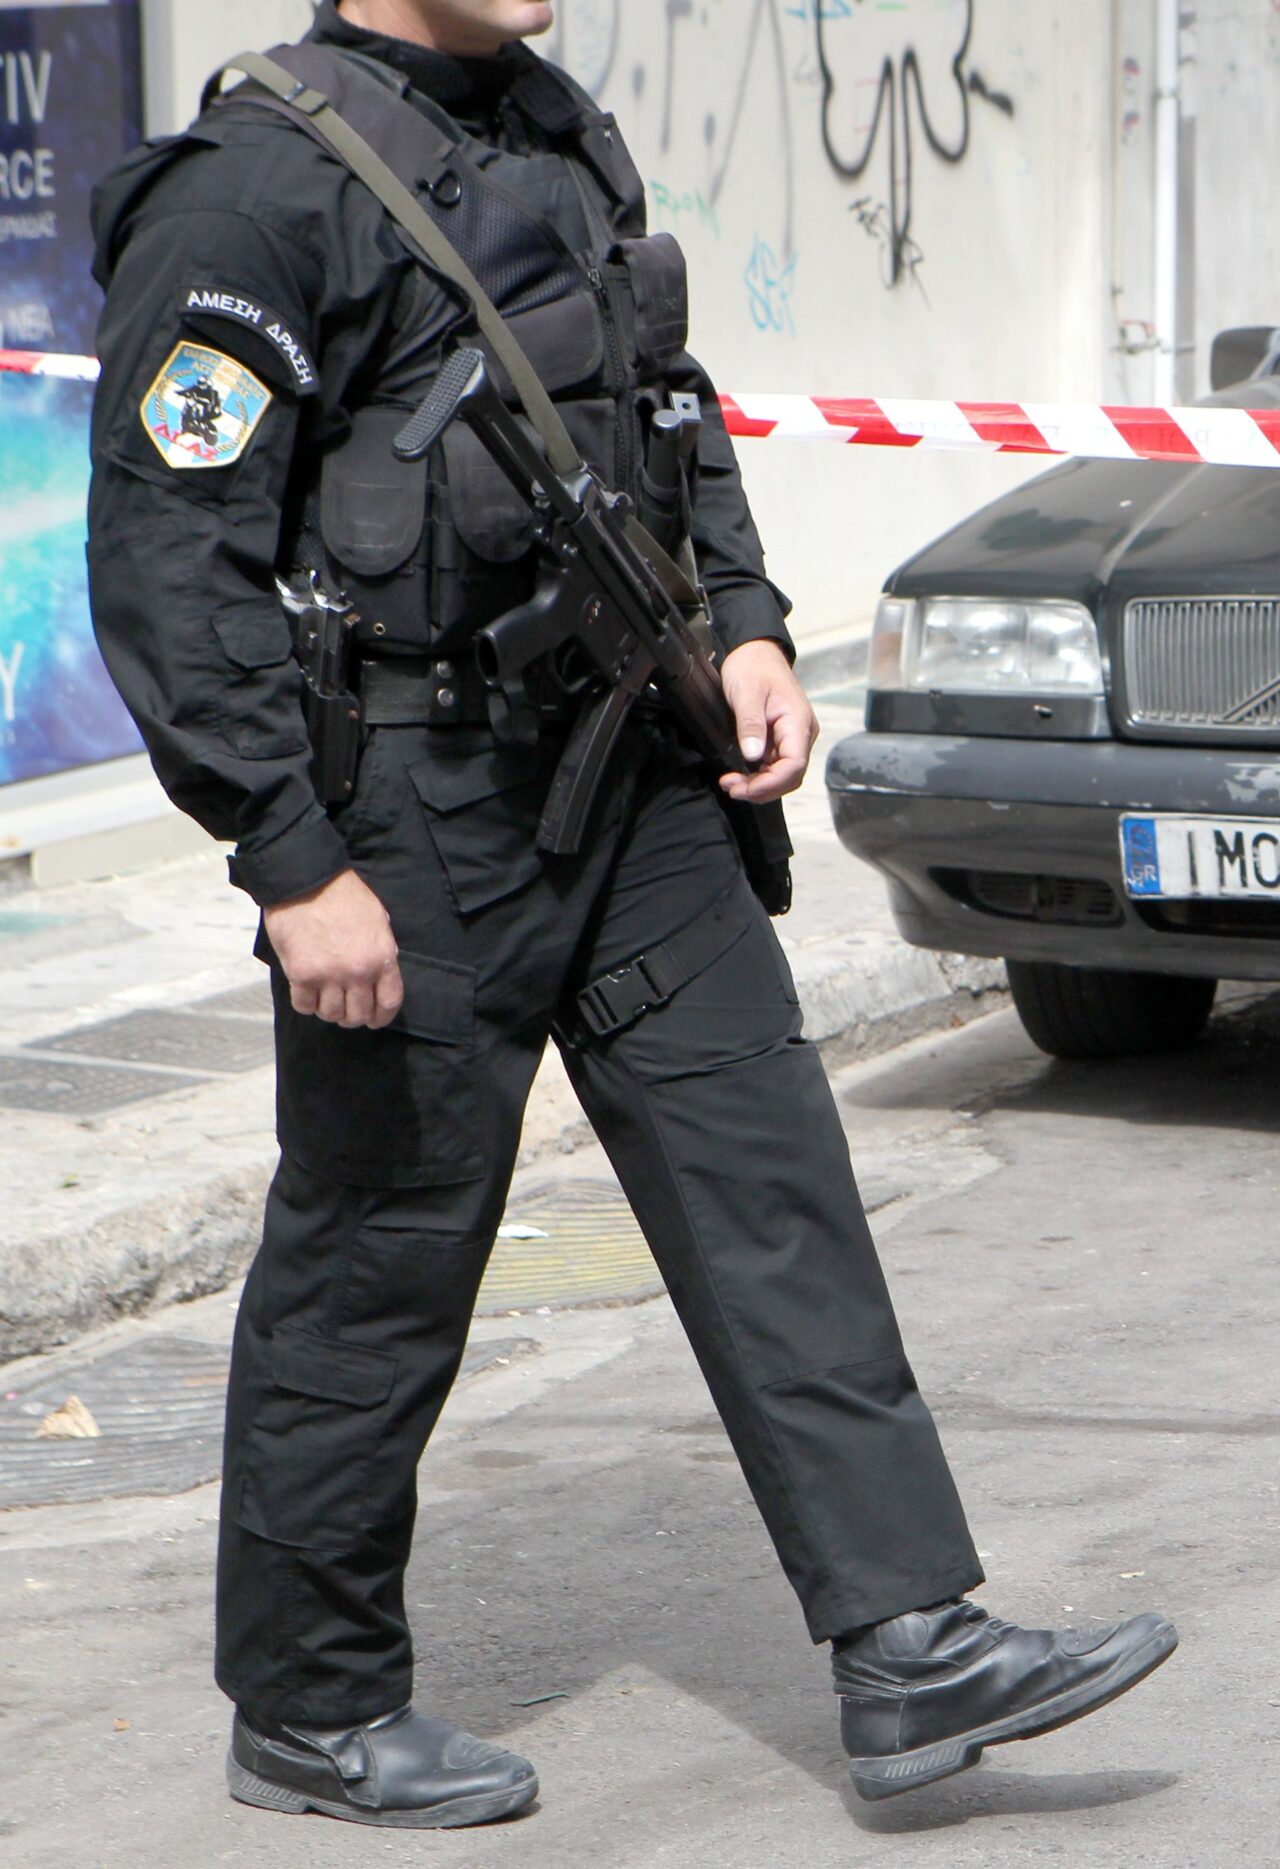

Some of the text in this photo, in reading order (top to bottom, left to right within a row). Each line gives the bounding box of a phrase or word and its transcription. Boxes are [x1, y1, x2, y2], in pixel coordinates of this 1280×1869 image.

[0, 50, 52, 125] IV
[187, 290, 262, 323] ΑΜΕΣΗ
[266, 323, 312, 385] ΔΡΑΣΗ
